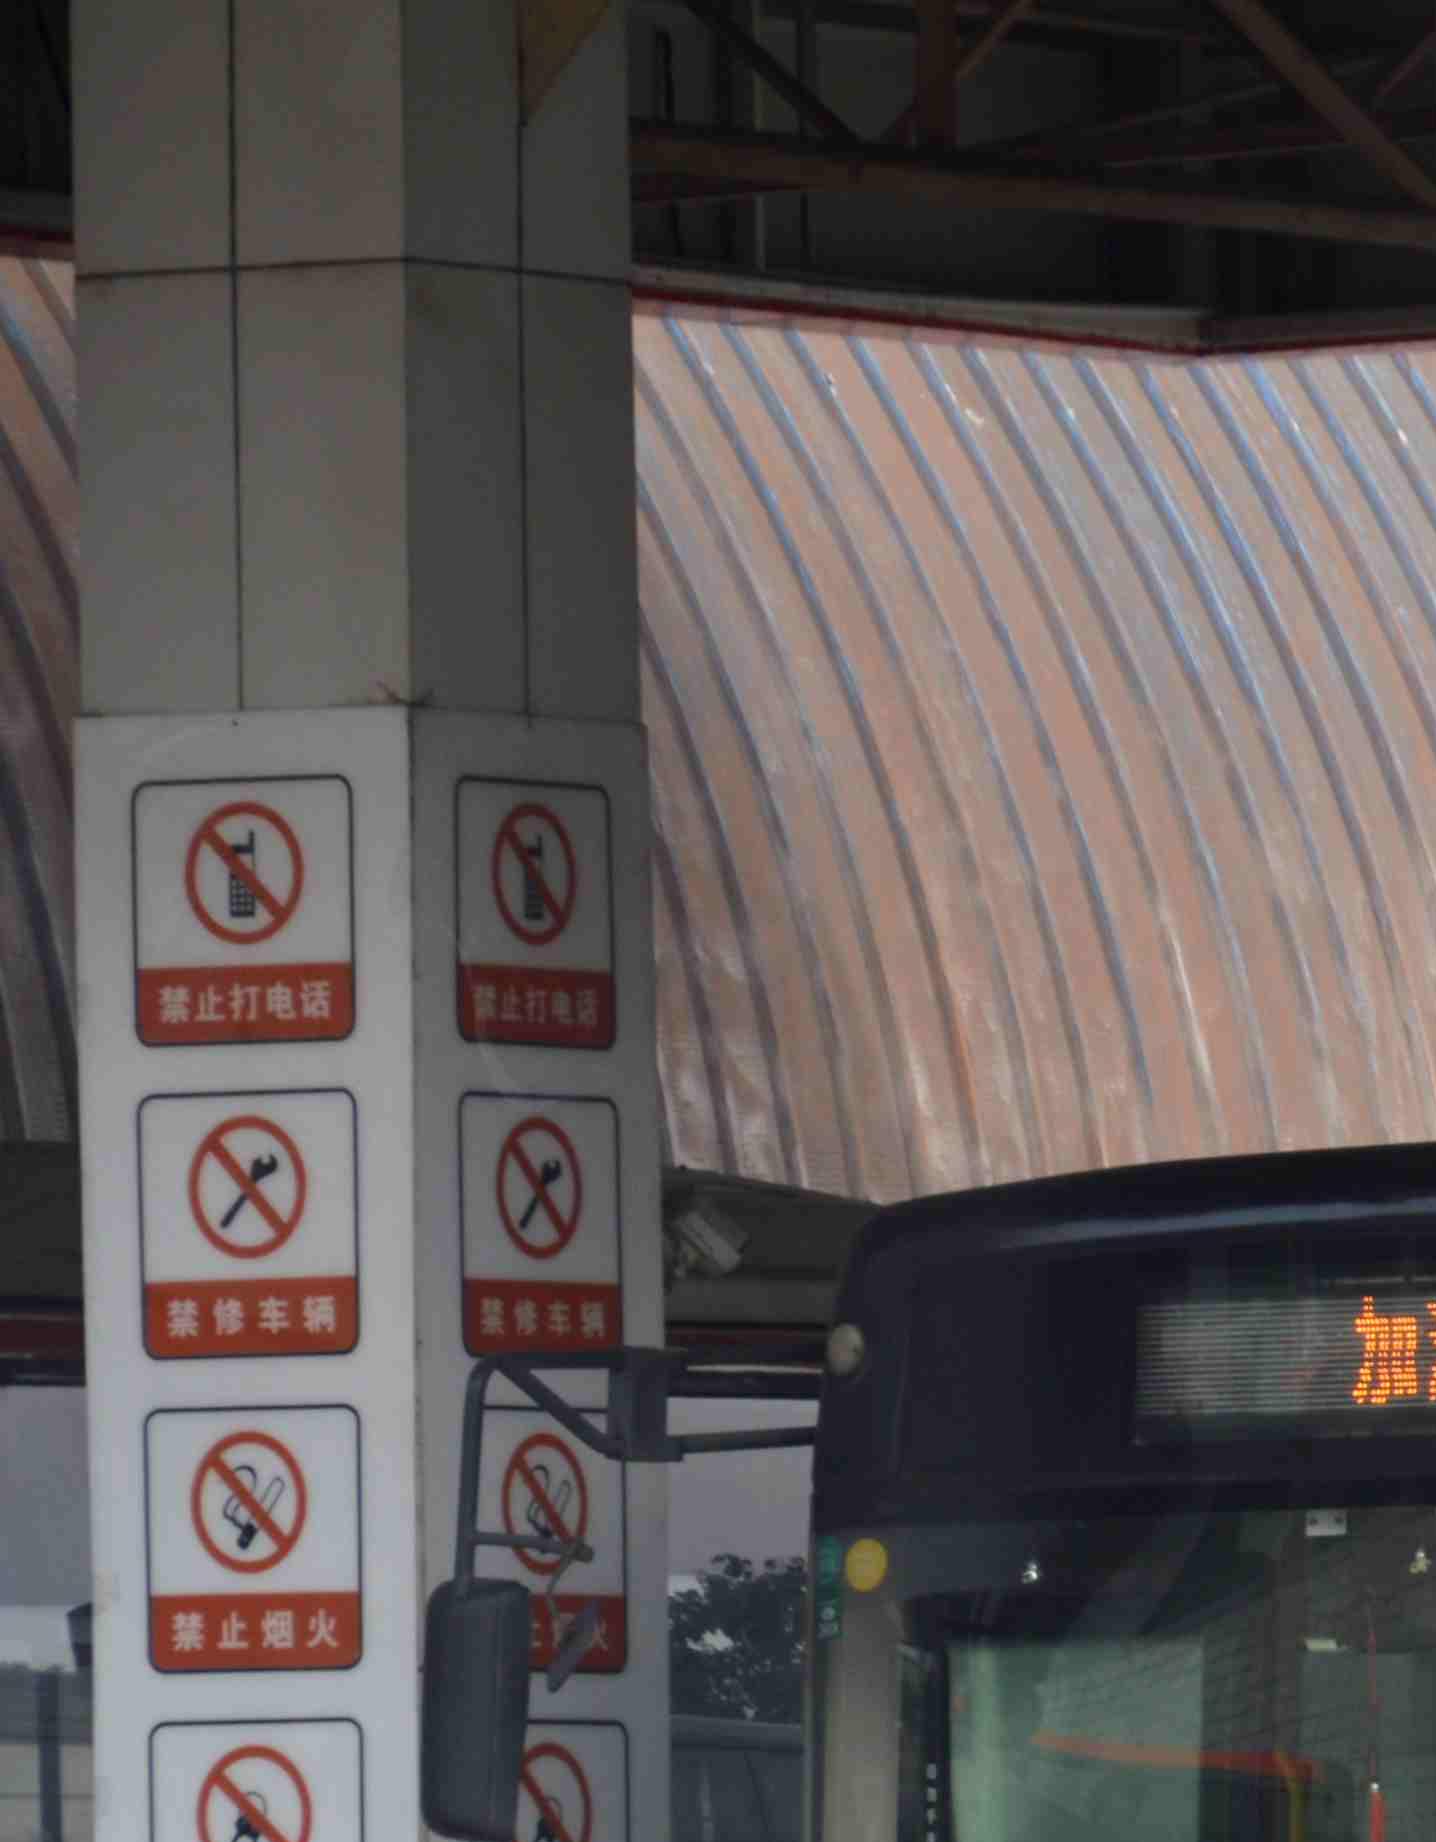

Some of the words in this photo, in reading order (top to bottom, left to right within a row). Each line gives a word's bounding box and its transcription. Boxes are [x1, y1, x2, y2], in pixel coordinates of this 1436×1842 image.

[158, 981, 332, 1024] 禁止打电话
[472, 984, 598, 1027] 禁止打电话
[166, 1295, 338, 1338] 禁修车辆
[480, 1298, 607, 1340] 禁修车辆
[170, 1607, 340, 1652] 禁止烟火
